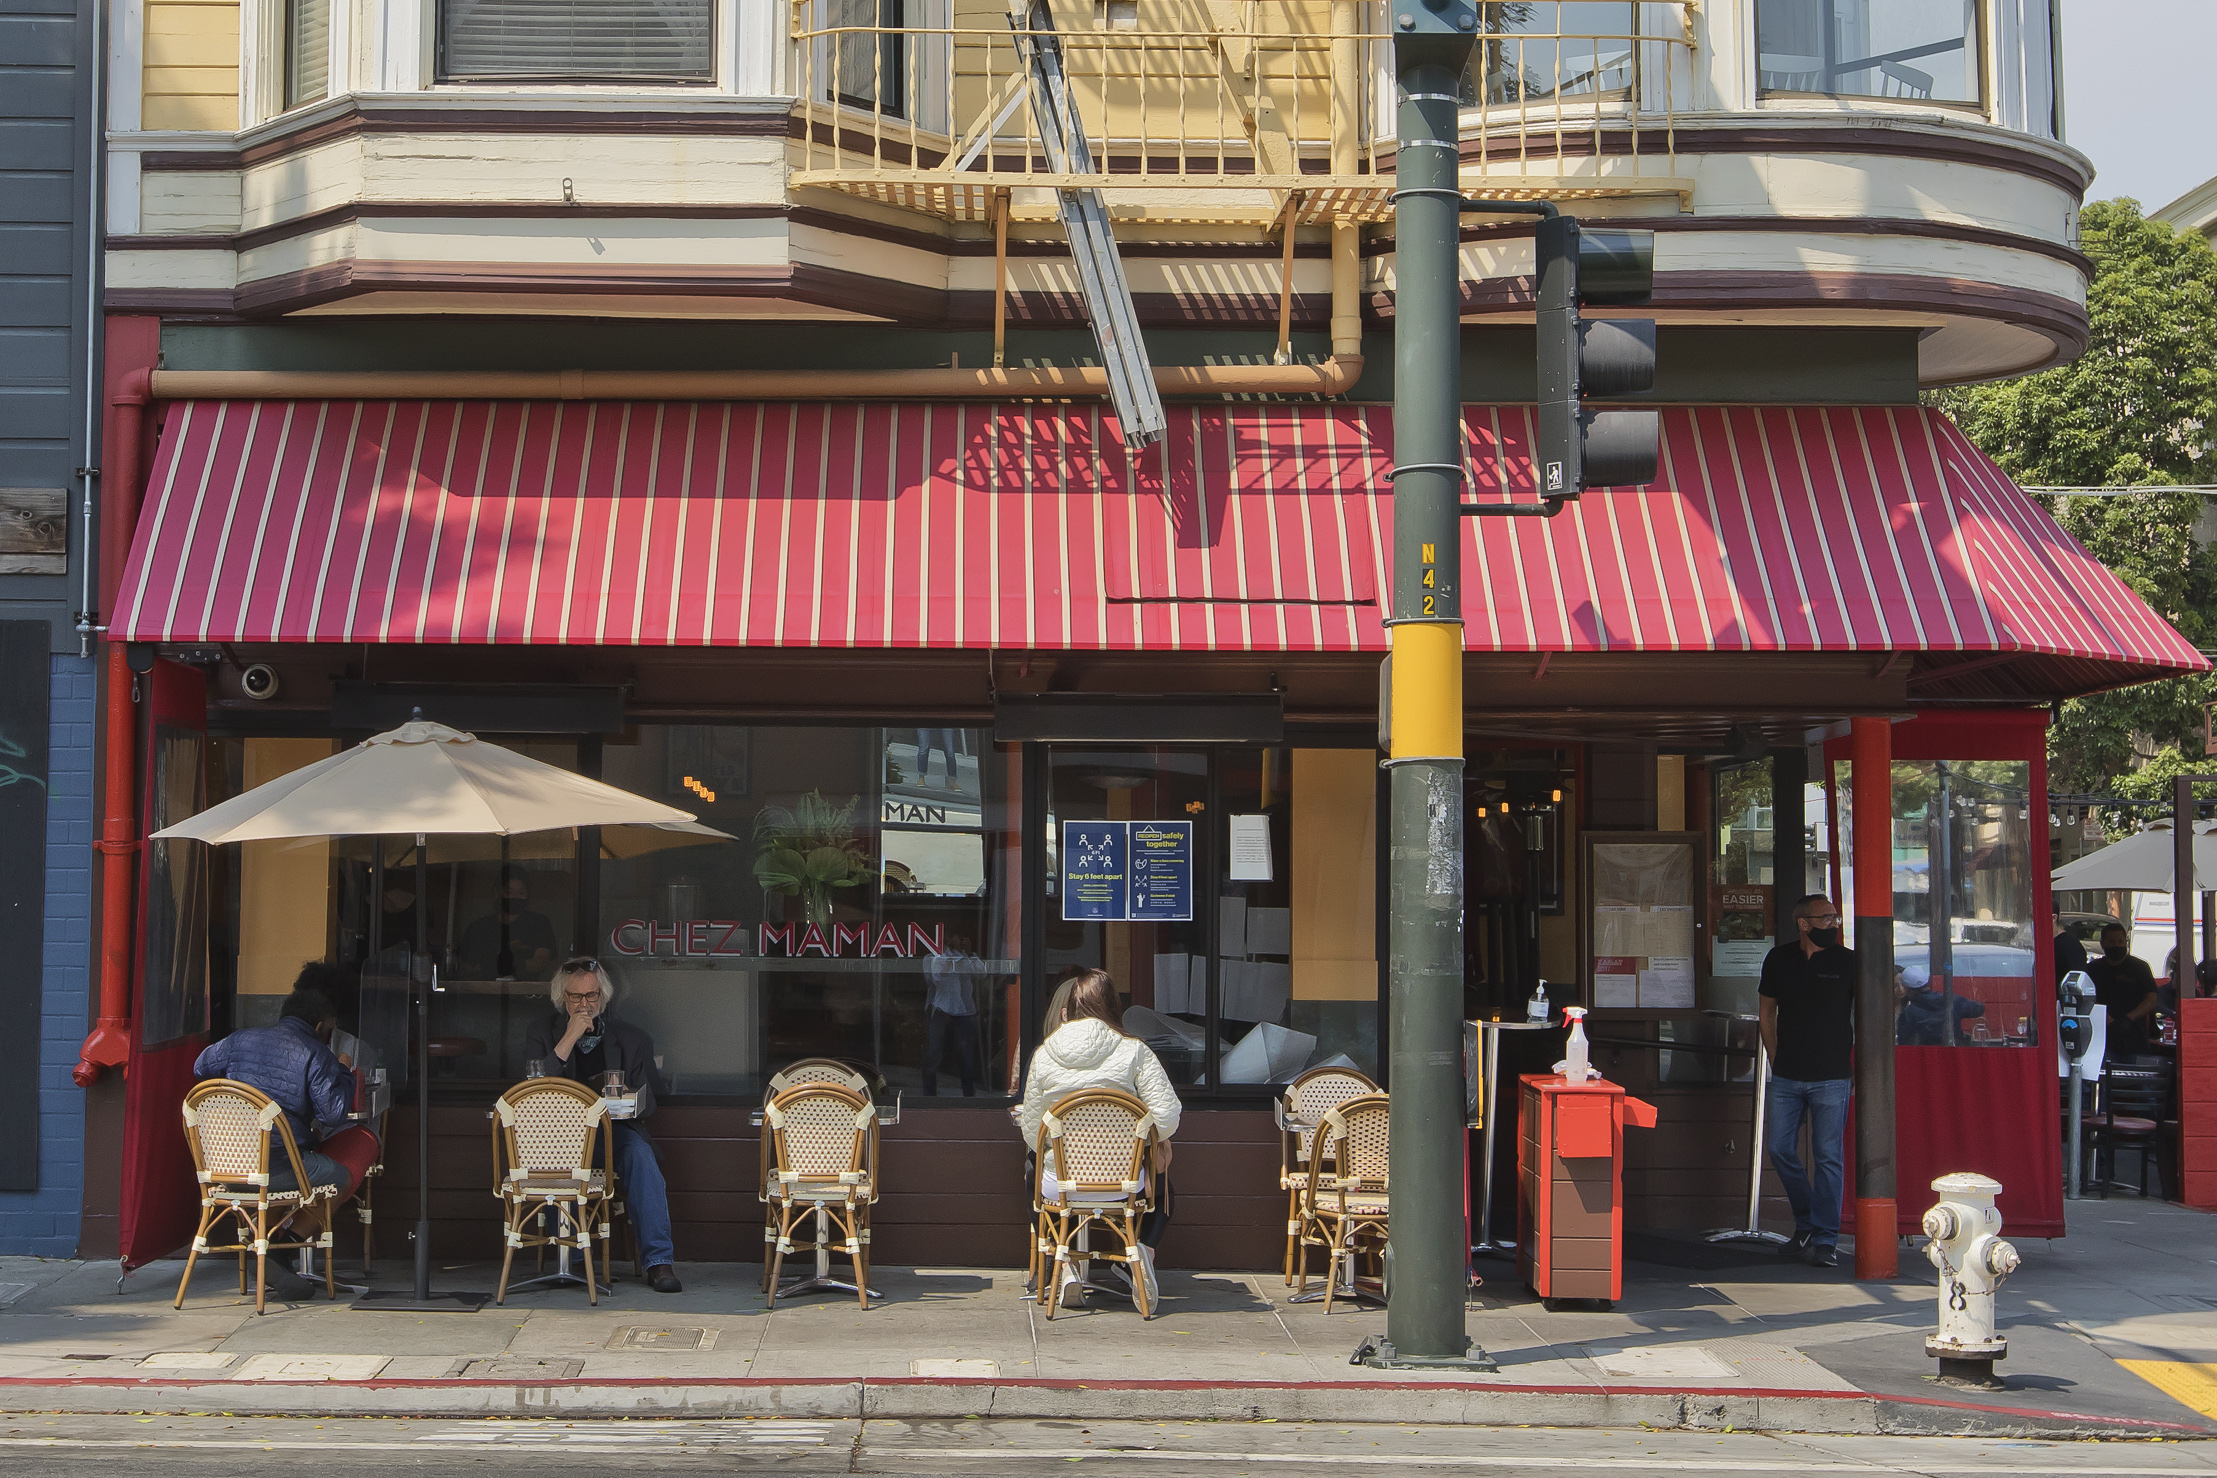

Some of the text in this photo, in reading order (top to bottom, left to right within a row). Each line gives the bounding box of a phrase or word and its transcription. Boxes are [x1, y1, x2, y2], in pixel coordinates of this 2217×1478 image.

[884, 801, 946, 824] MAN
[1162, 831, 1184, 840] safely
[1146, 840, 1177, 849] together
[1104, 873, 1123, 881] apart
[1722, 894, 1764, 905] EASIER
[611, 919, 945, 958] CHEZ MAMAN
